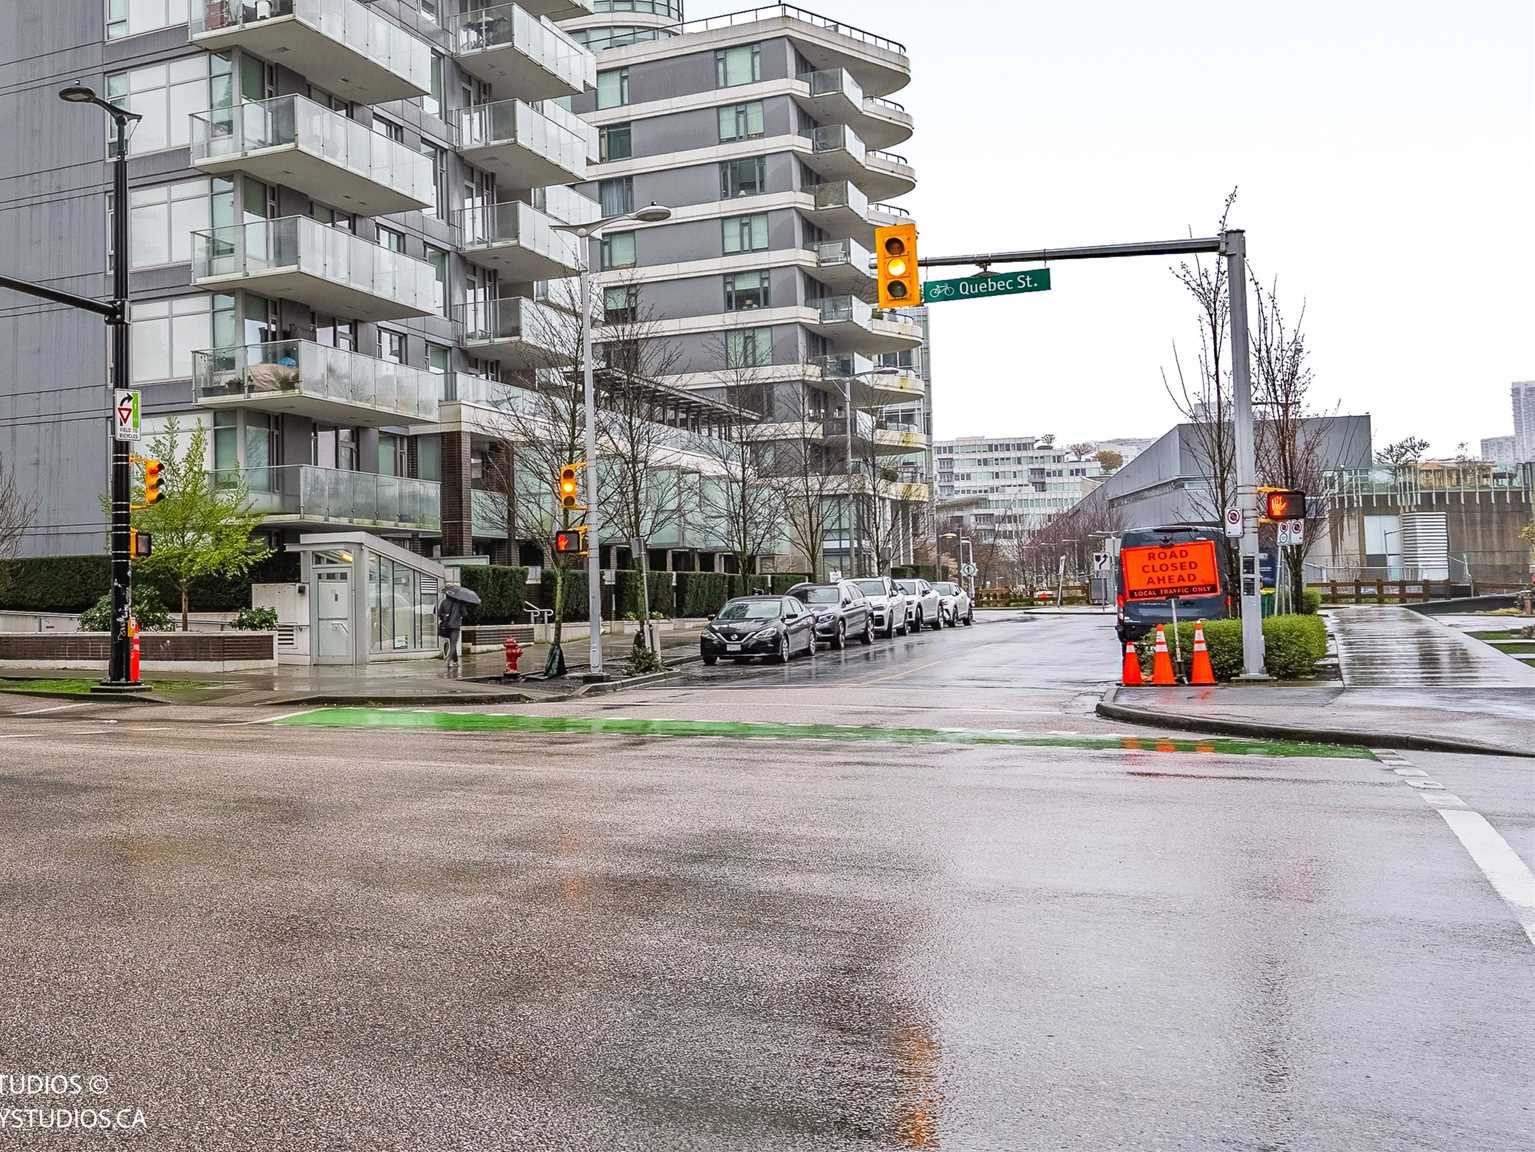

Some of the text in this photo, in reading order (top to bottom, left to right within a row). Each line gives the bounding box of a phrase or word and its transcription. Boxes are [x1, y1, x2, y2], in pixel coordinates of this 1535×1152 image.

[959, 274, 1038, 295] Quebec St.
[1148, 550, 1188, 560] ROAD
[1142, 561, 1198, 574] CLOSED
[1147, 574, 1196, 585] AHEAD
[1160, 587, 1190, 596] TRAFFIC
[1192, 585, 1212, 594] ONLY
